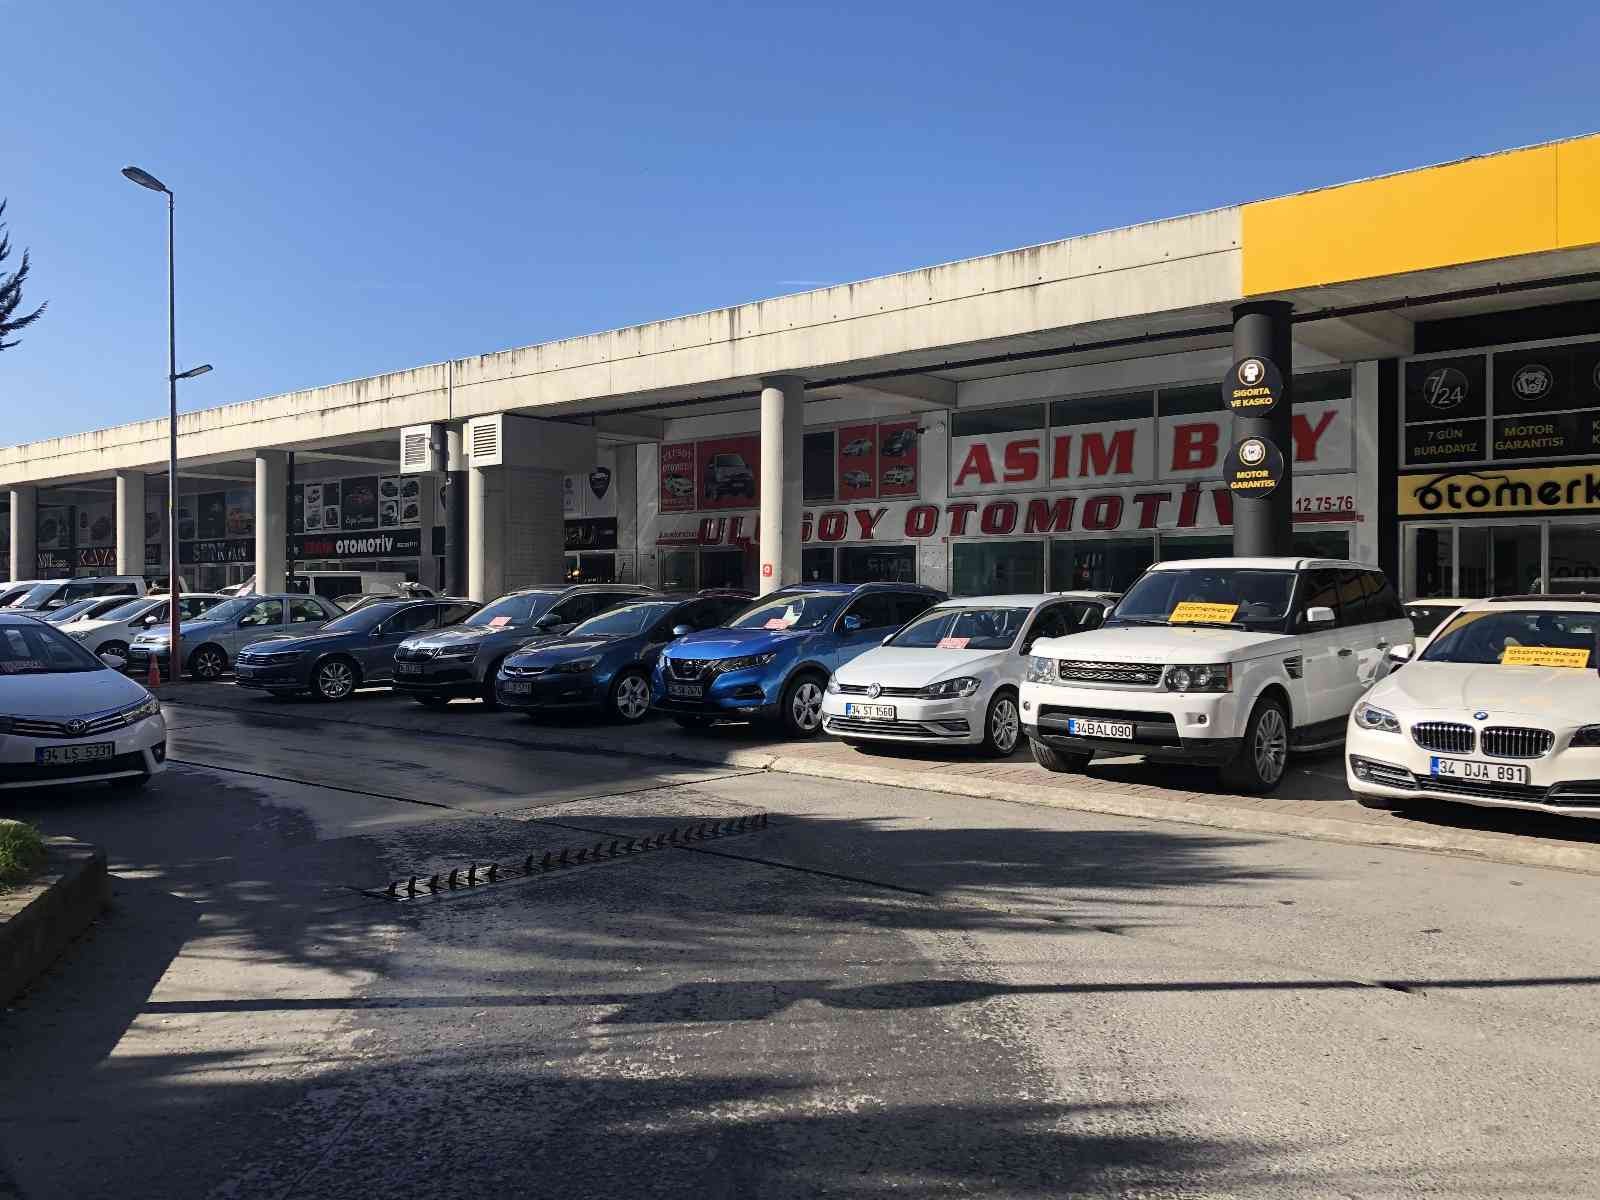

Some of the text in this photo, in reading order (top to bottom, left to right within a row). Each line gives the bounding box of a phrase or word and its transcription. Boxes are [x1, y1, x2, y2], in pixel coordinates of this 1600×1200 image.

[1427, 369, 1463, 404] 7/24
[1231, 397, 1273, 408] VE KASKO
[1427, 428, 1464, 441] 7 GÜN
[1504, 424, 1553, 437] MOTOR
[954, 410, 1338, 486] ASIM BY
[1414, 442, 1478, 456] BURADAYIZ
[1236, 470, 1269, 479] MOTOR
[1295, 495, 1353, 512] 12 75-76
[335, 534, 394, 554] OTOMOTİV
[864, 705, 872, 715] ST
[1075, 721, 1131, 737] 34BAL090
[64, 747, 79, 760] LS
[1440, 760, 1524, 782] 34 DJA 891
